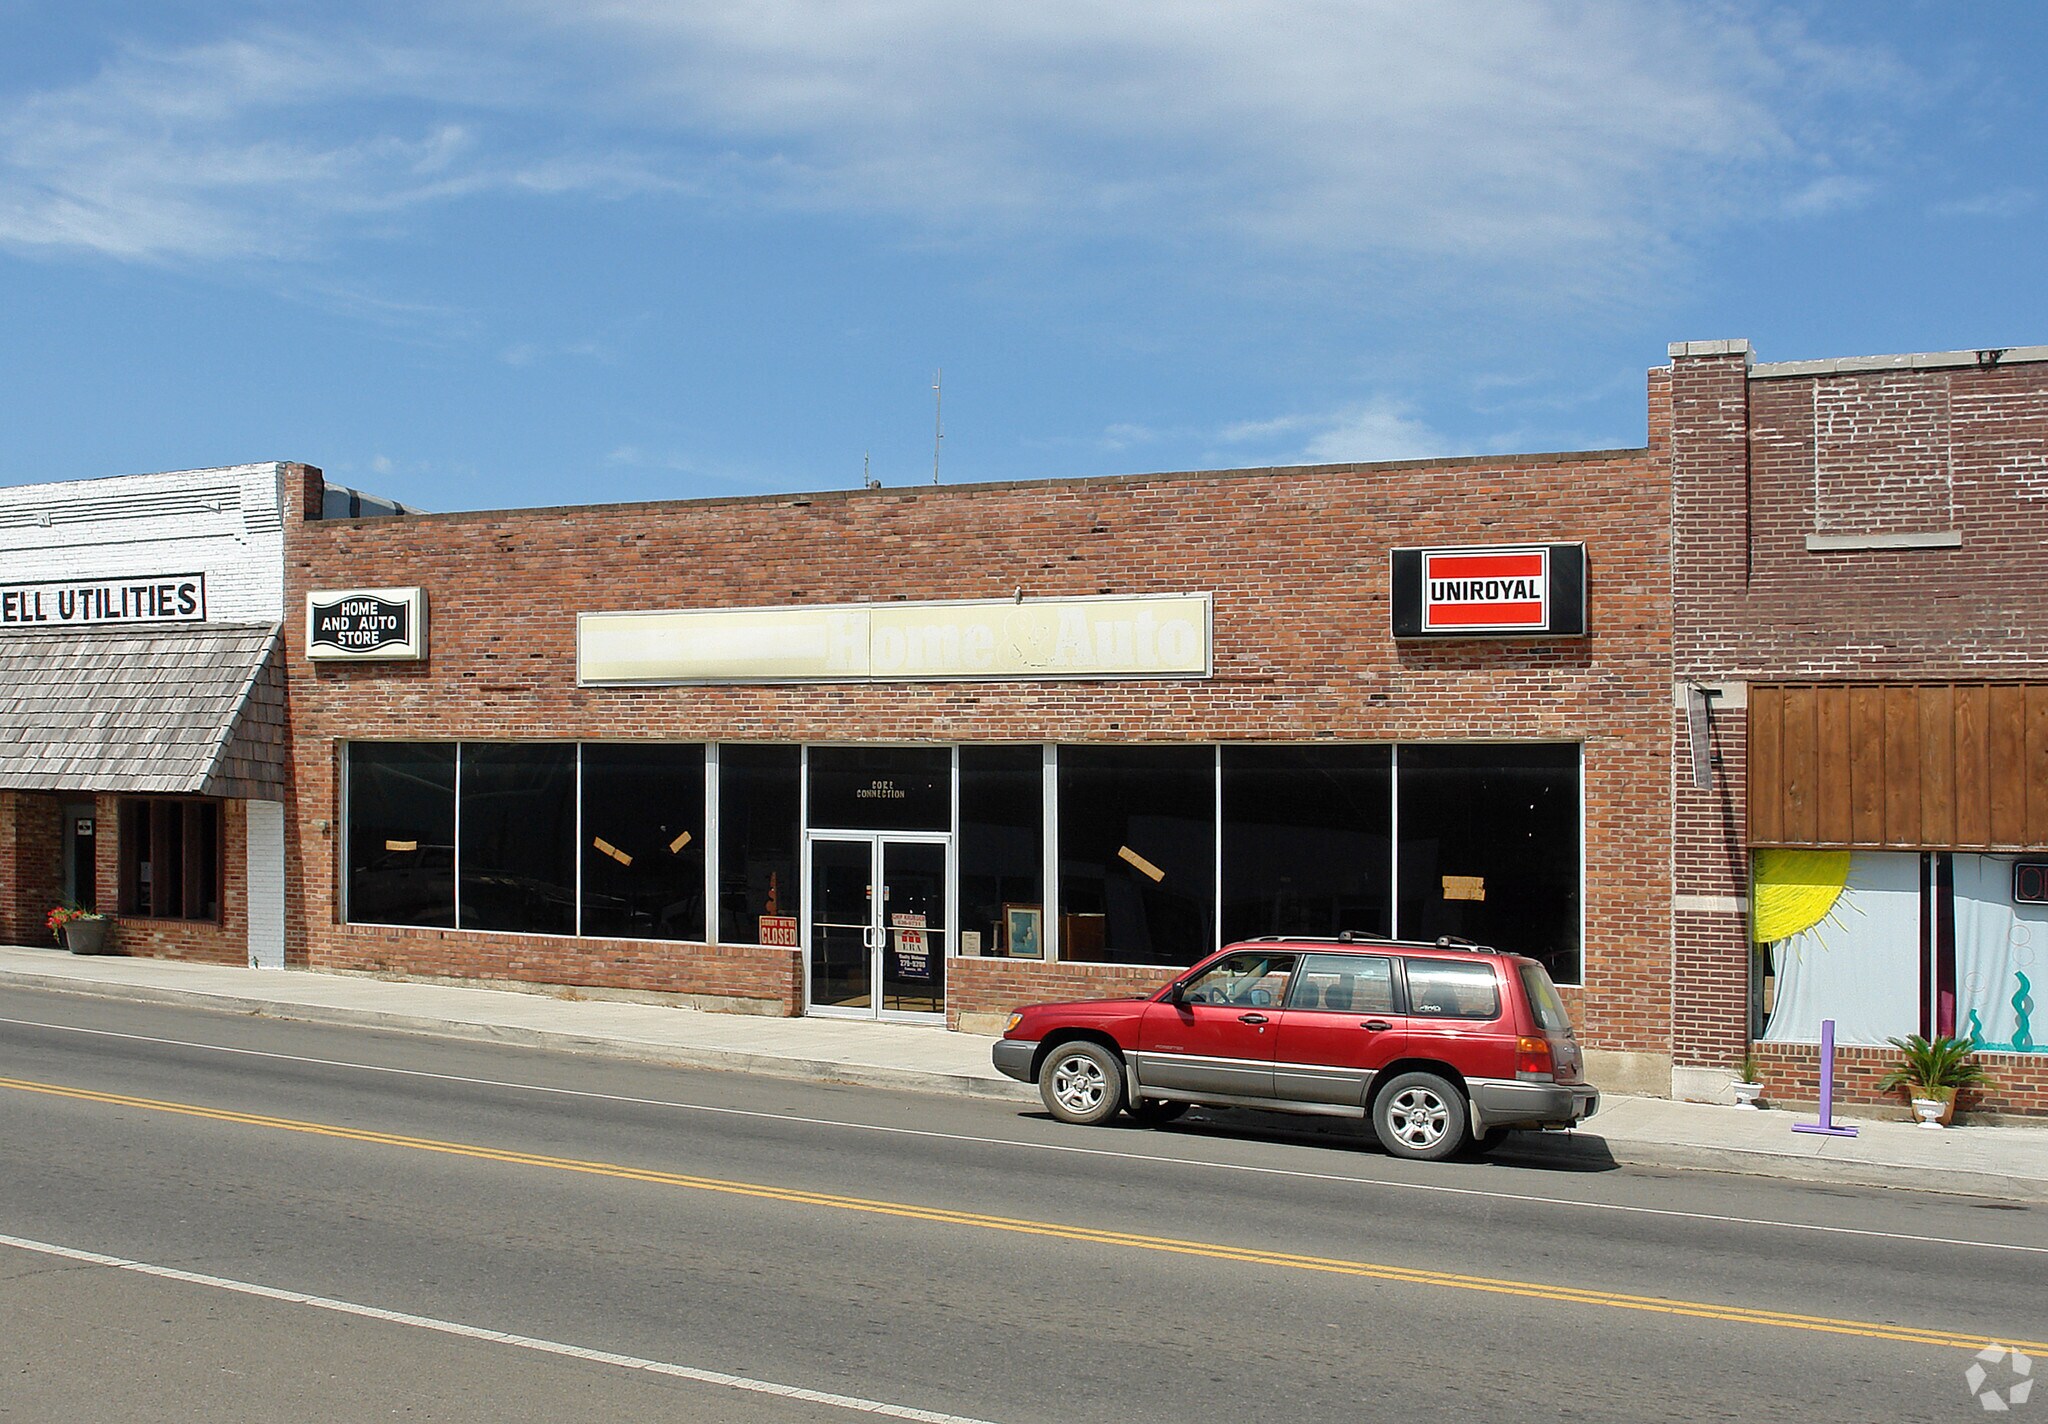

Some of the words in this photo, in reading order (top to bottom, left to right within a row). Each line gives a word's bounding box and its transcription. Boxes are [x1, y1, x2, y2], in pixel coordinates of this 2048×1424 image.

[1431, 579, 1541, 601] UNIROYAL
[2, 591, 47, 622] ELL
[58, 583, 197, 621] UTILITIES
[341, 601, 379, 616] HOME
[321, 616, 350, 631] AND
[359, 615, 397, 630] AUTO
[337, 631, 380, 645] STORE
[826, 612, 995, 671] Home
[1055, 606, 1198, 669] Auto
[856, 789, 905, 798] CONNECTION
[761, 927, 796, 945] CLOSED
